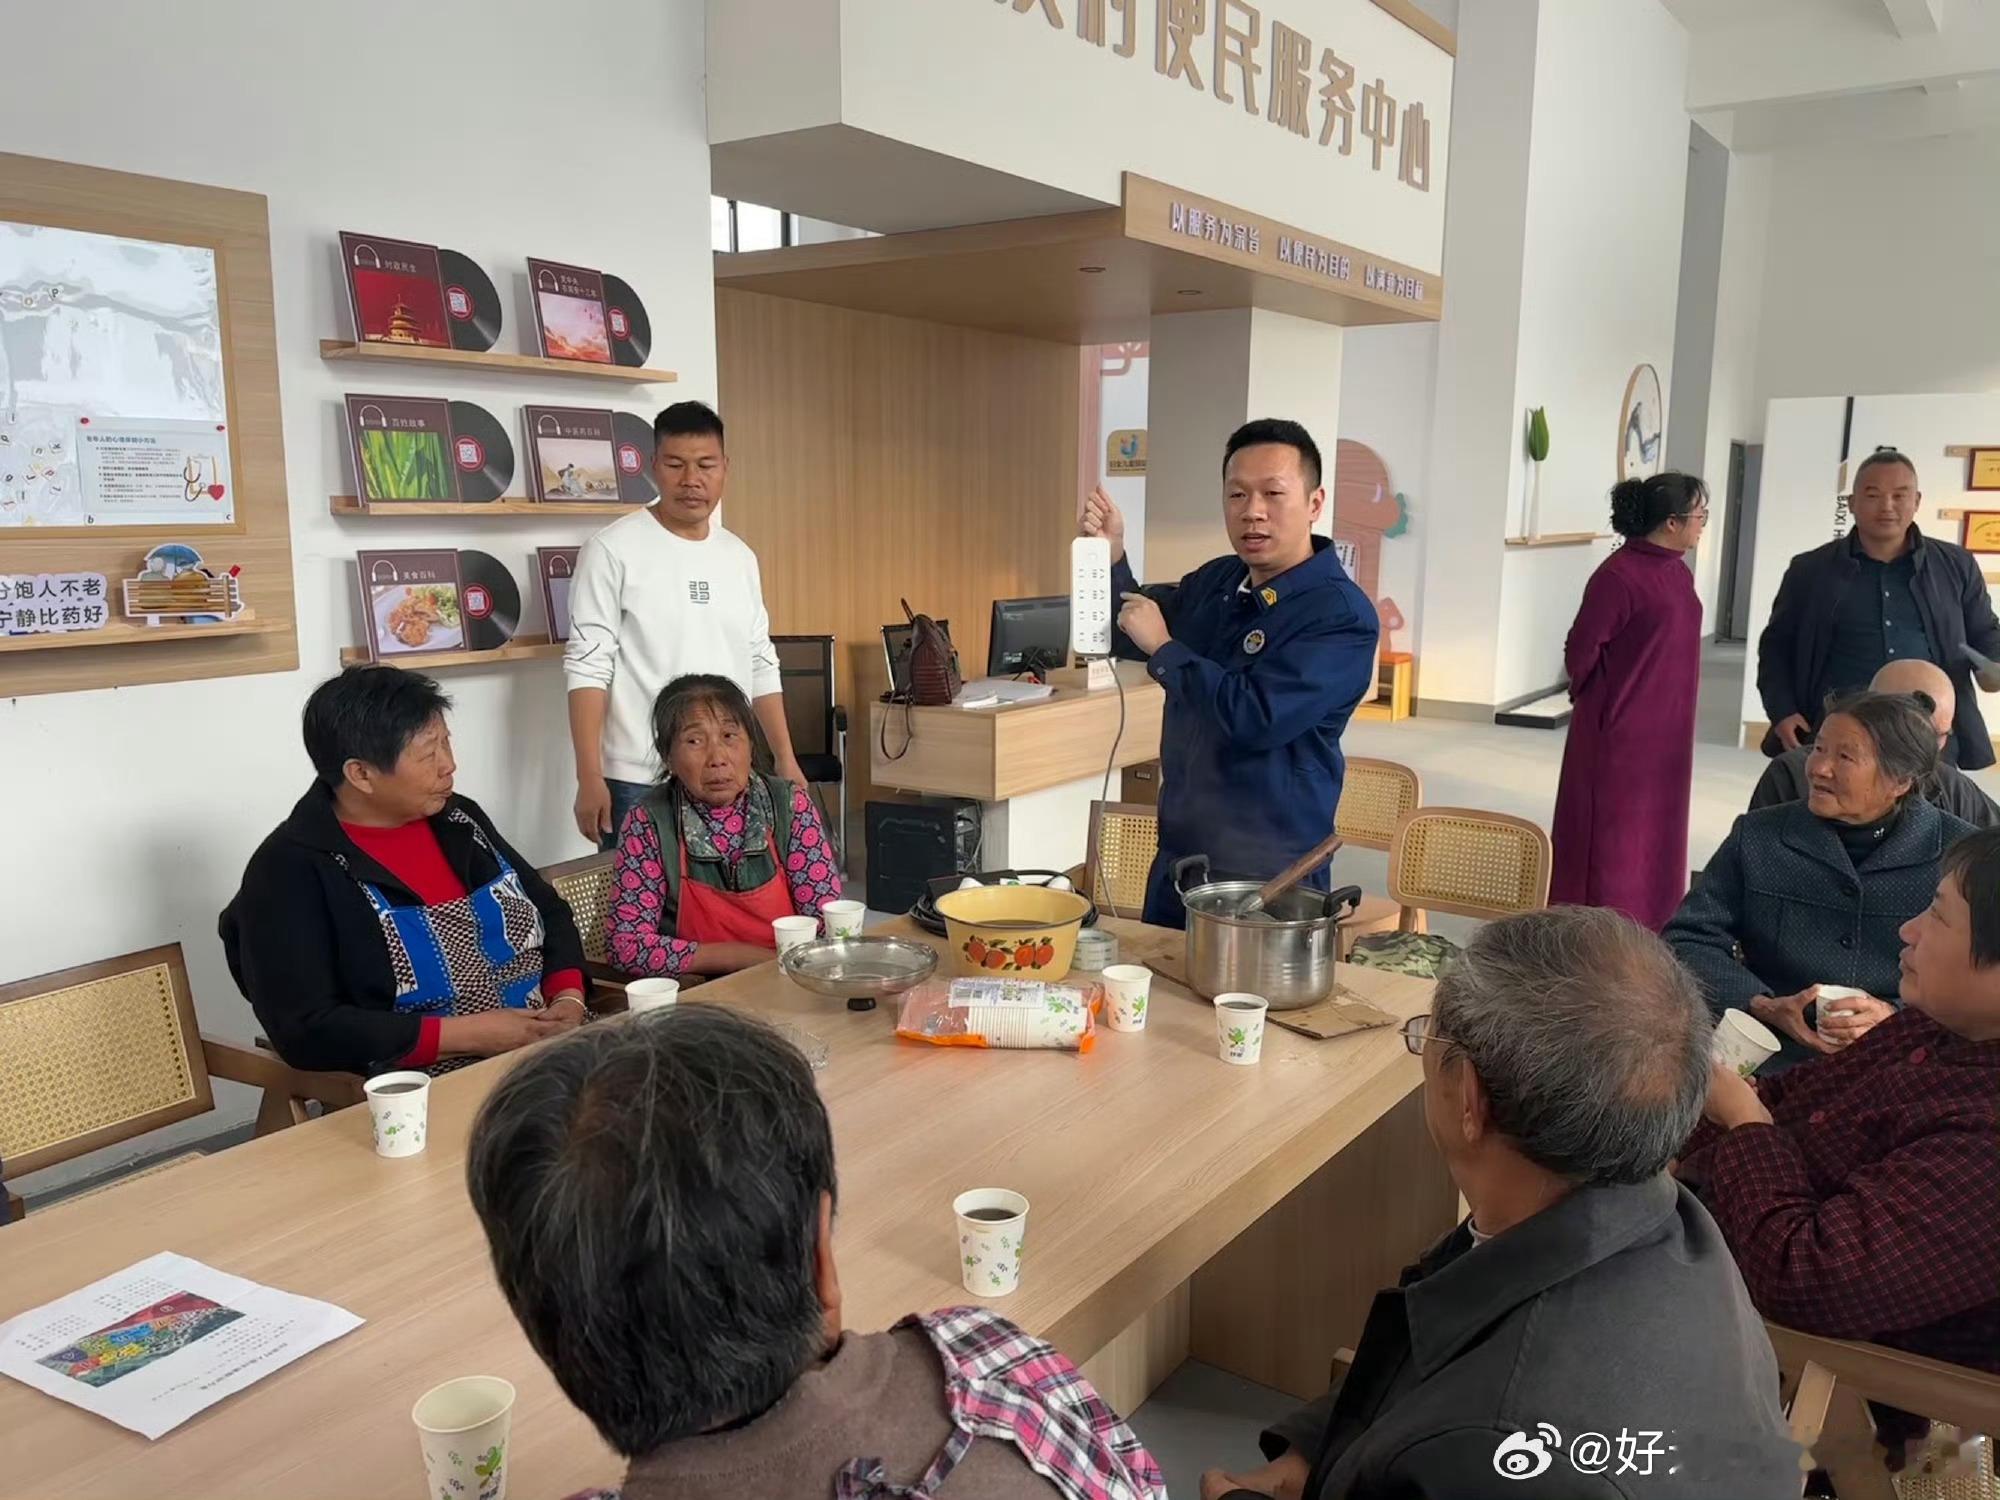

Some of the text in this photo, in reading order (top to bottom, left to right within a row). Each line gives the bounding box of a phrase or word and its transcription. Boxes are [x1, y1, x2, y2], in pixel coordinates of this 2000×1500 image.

[994, 0, 1431, 193] 便民服务中心
[1170, 201, 1260, 255] 以服务为宗旨
